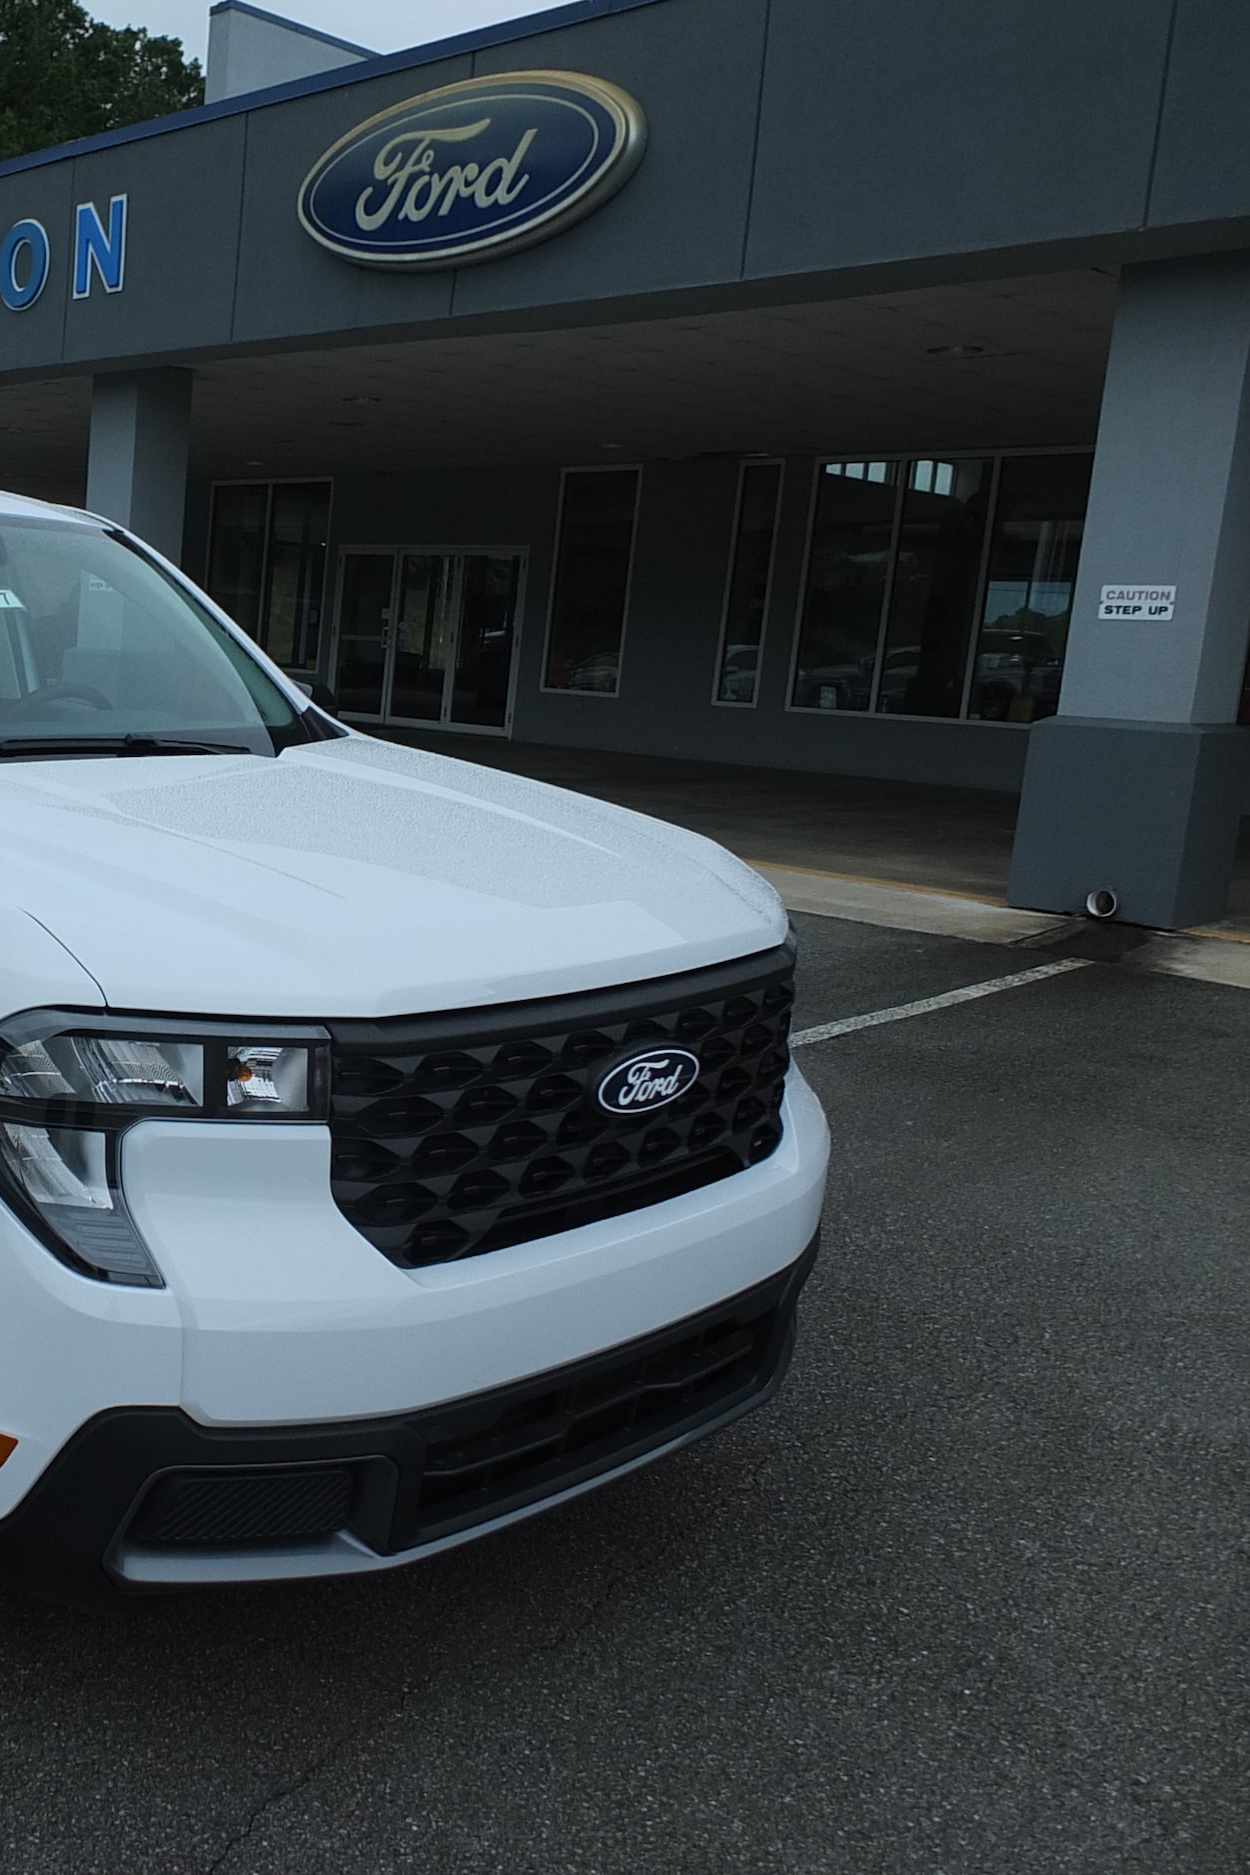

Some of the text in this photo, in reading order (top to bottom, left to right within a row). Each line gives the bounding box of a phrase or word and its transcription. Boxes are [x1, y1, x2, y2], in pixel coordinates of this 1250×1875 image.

[354, 117, 538, 232] Ford
[1105, 590, 1172, 601] CAUTION
[1103, 605, 1169, 616] STEP UP
[617, 1059, 684, 1106] Ford
